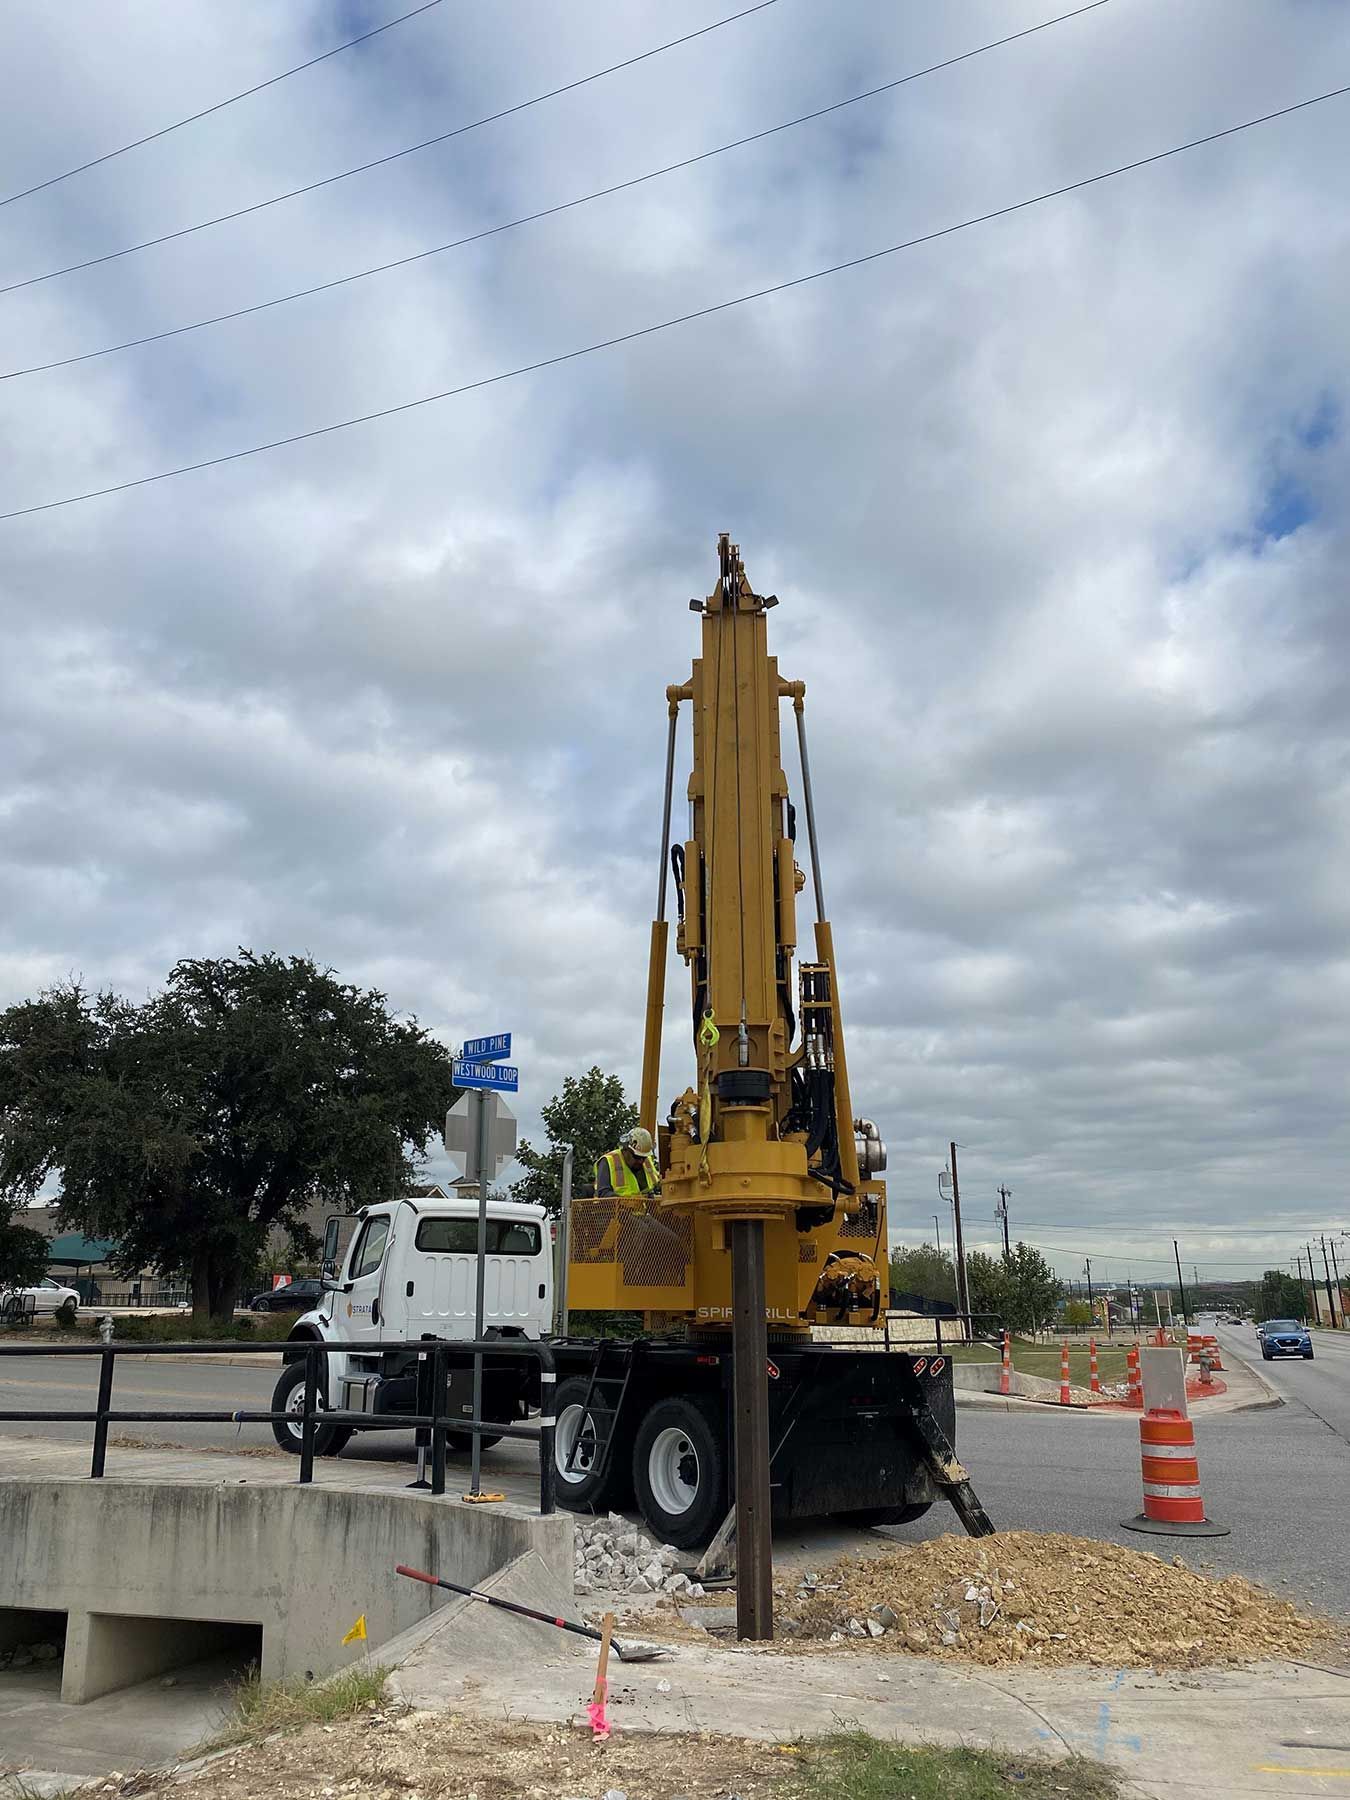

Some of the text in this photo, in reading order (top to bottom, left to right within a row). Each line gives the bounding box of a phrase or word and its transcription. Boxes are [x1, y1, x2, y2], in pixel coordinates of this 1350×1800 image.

[468, 1036, 507, 1054] WILD PINE
[454, 1062, 517, 1082] WESTWOOD LOOP
